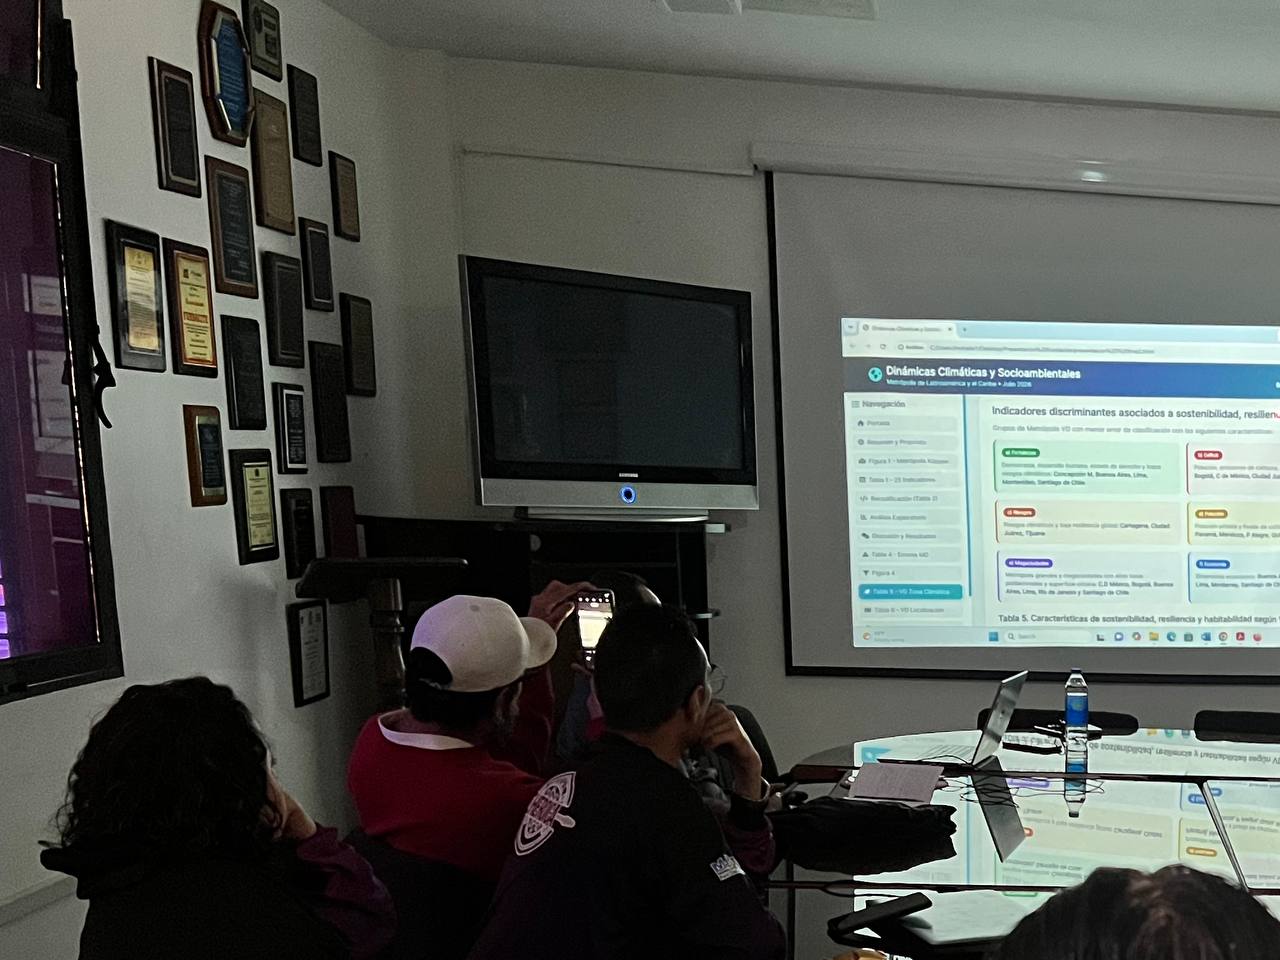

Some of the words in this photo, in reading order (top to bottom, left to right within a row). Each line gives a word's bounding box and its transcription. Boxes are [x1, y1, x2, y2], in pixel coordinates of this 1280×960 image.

[886, 365, 936, 378] Dinámicas
[937, 366, 988, 378] Climáticas
[988, 369, 995, 380] y
[997, 367, 1082, 380] Socioambientales
[862, 400, 906, 409] Navegación
[991, 406, 1047, 416] Indicadores
[1049, 407, 1117, 418] discriminantes
[1118, 408, 1166, 418] asociados
[1167, 410, 1175, 418] a
[1175, 409, 1242, 421] sostenibilidad,
[998, 614, 1020, 623] Tabla
[1030, 614, 1089, 623] Características
[1090, 615, 1101, 623] de
[1101, 615, 1157, 625] sostenibilidad,
[1158, 615, 1196, 624] resiliencia
[1196, 617, 1203, 625] y
[1203, 615, 1253, 625] habitabilidad
[1253, 616, 1276, 626] según
